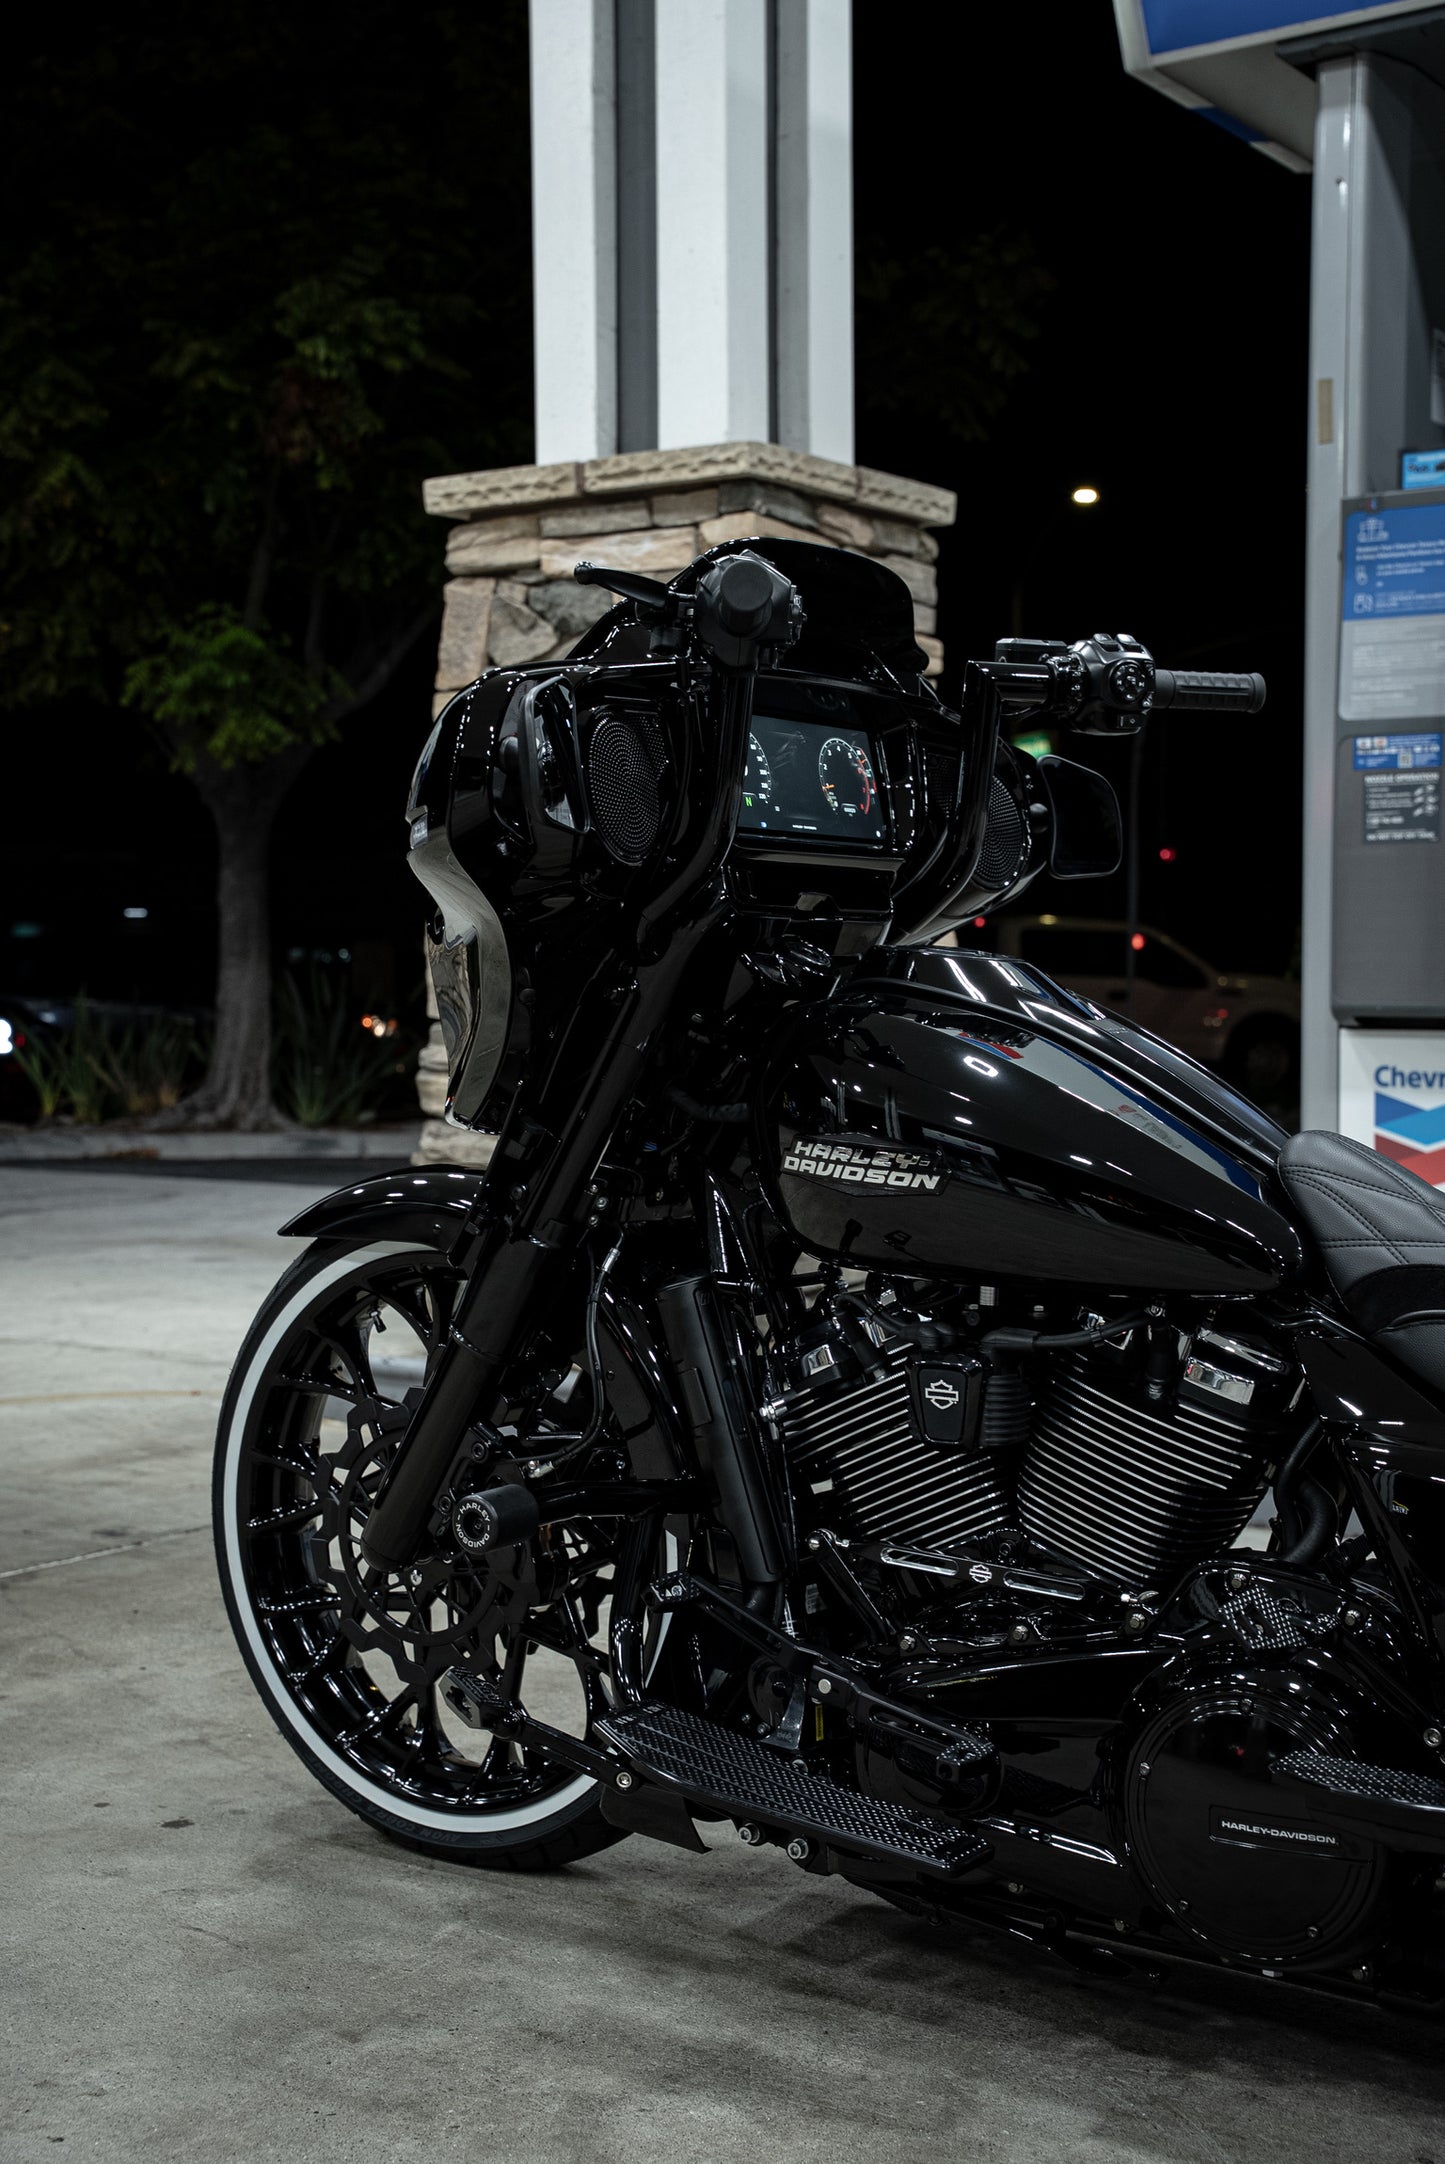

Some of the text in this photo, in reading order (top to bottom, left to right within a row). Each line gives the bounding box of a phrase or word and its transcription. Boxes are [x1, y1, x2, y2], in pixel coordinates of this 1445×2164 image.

[745, 797, 752, 806] N
[783, 1155, 941, 1190] DAVIDSON
[455, 1502, 491, 1548] HARLEY DAVIDSON
[1221, 1820, 1336, 1844] HARLEY-DAVIDSON
